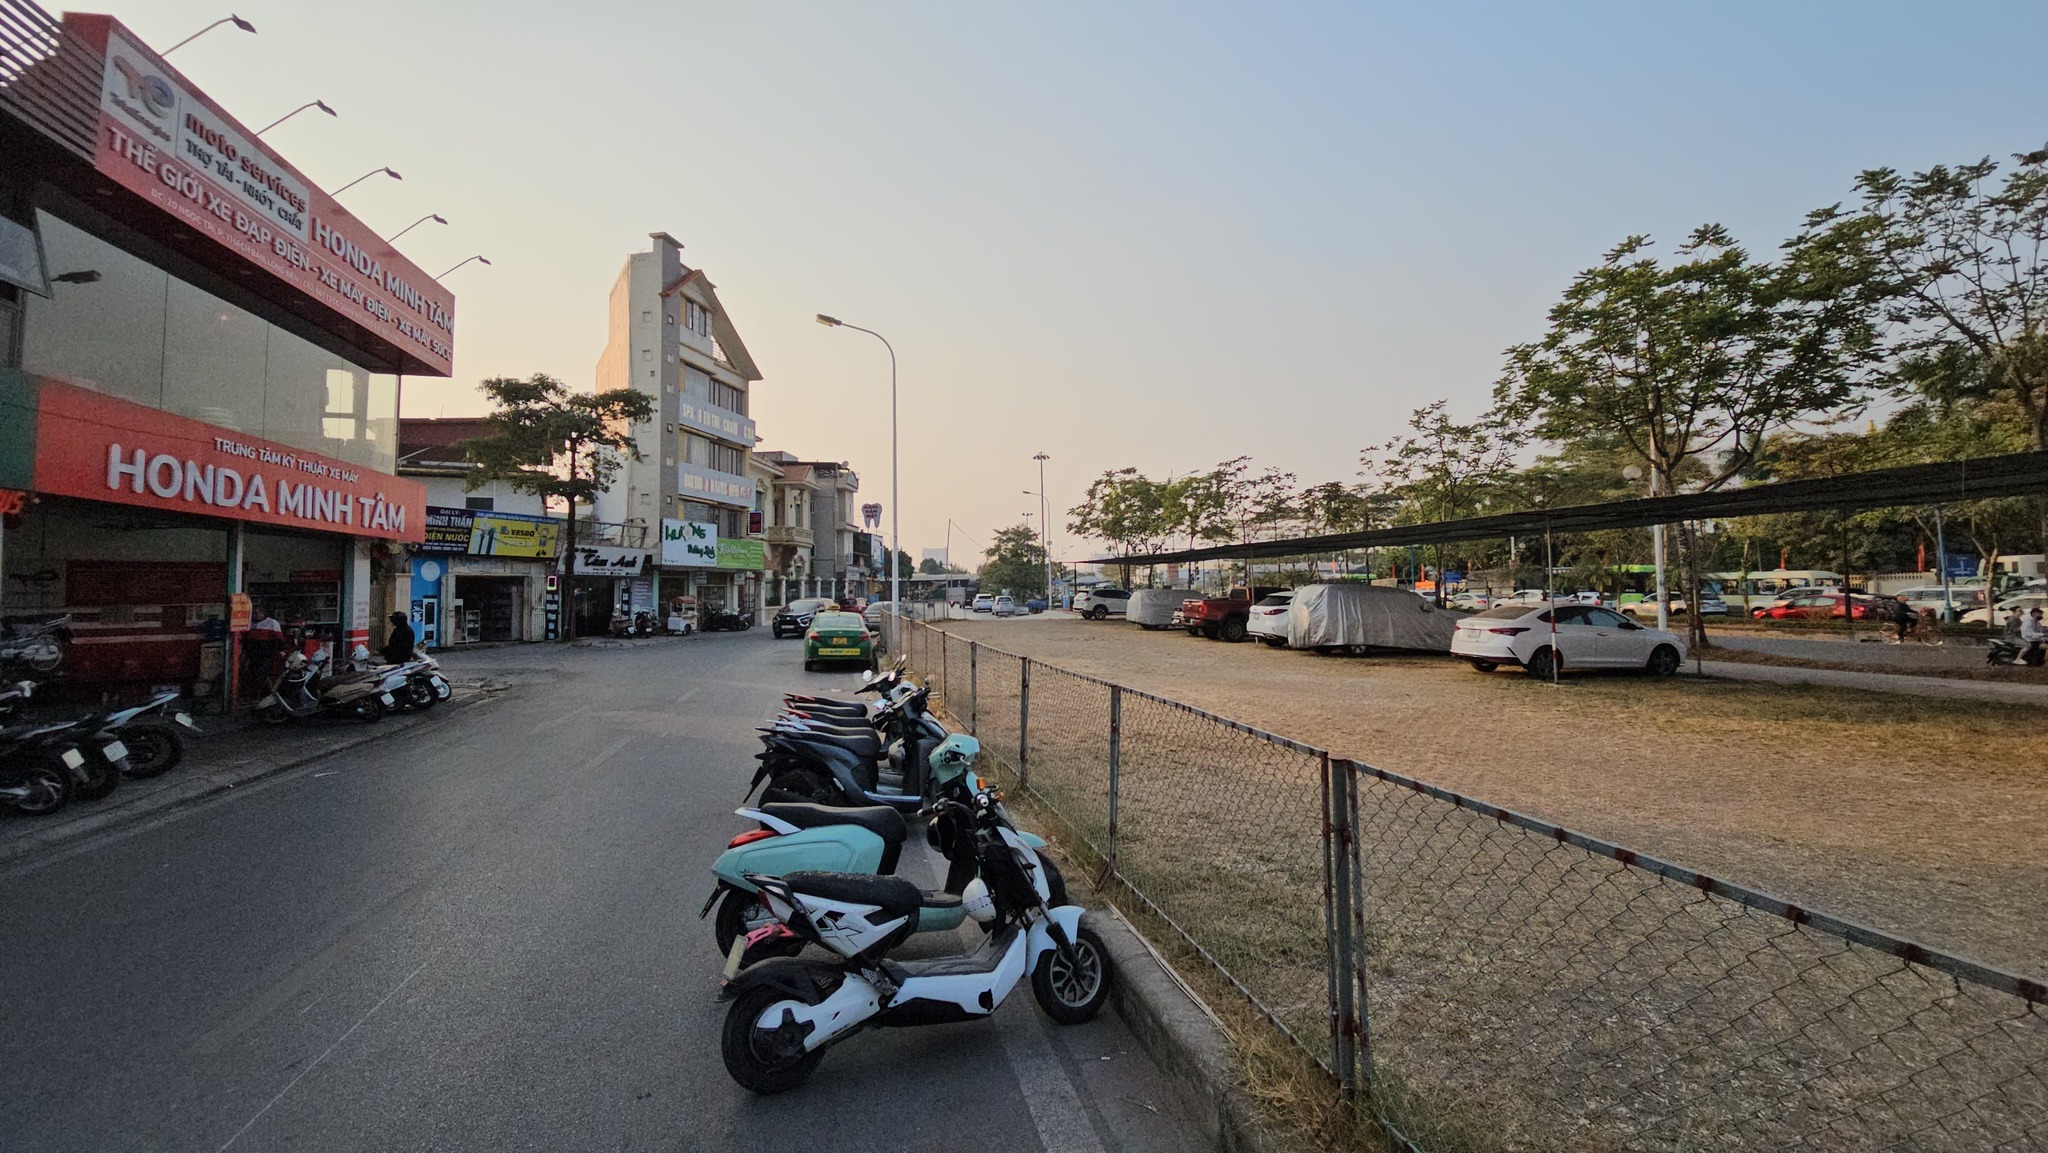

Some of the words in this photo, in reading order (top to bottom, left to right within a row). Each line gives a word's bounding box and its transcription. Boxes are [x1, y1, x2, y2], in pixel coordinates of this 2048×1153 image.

[185, 139, 212, 169] THỢ
[185, 113, 238, 162] moto
[239, 156, 306, 213] services
[109, 126, 158, 174] THẾ
[161, 164, 203, 204] GIỚI
[204, 192, 232, 222] XE
[236, 211, 271, 244] ĐẠP
[275, 237, 310, 272] ĐIỆN
[321, 266, 337, 290] XE
[340, 279, 364, 305] MÁY
[365, 296, 392, 322] ĐIỆN
[399, 318, 413, 338] XE
[413, 326, 430, 346] MÁY
[314, 217, 383, 286] HONDA
[385, 271, 424, 315] MINH
[427, 301, 454, 334] TÂM
[107, 443, 269, 513] HONDA
[279, 480, 352, 524] MINH
[359, 492, 404, 533] TÂM
[214, 437, 255, 459] TRUNG
[259, 447, 280, 466] TÂM
[283, 453, 296, 469] KỸ
[297, 460, 327, 478] THUẬT
[329, 467, 341, 480] XE
[342, 469, 359, 483] MÁY
